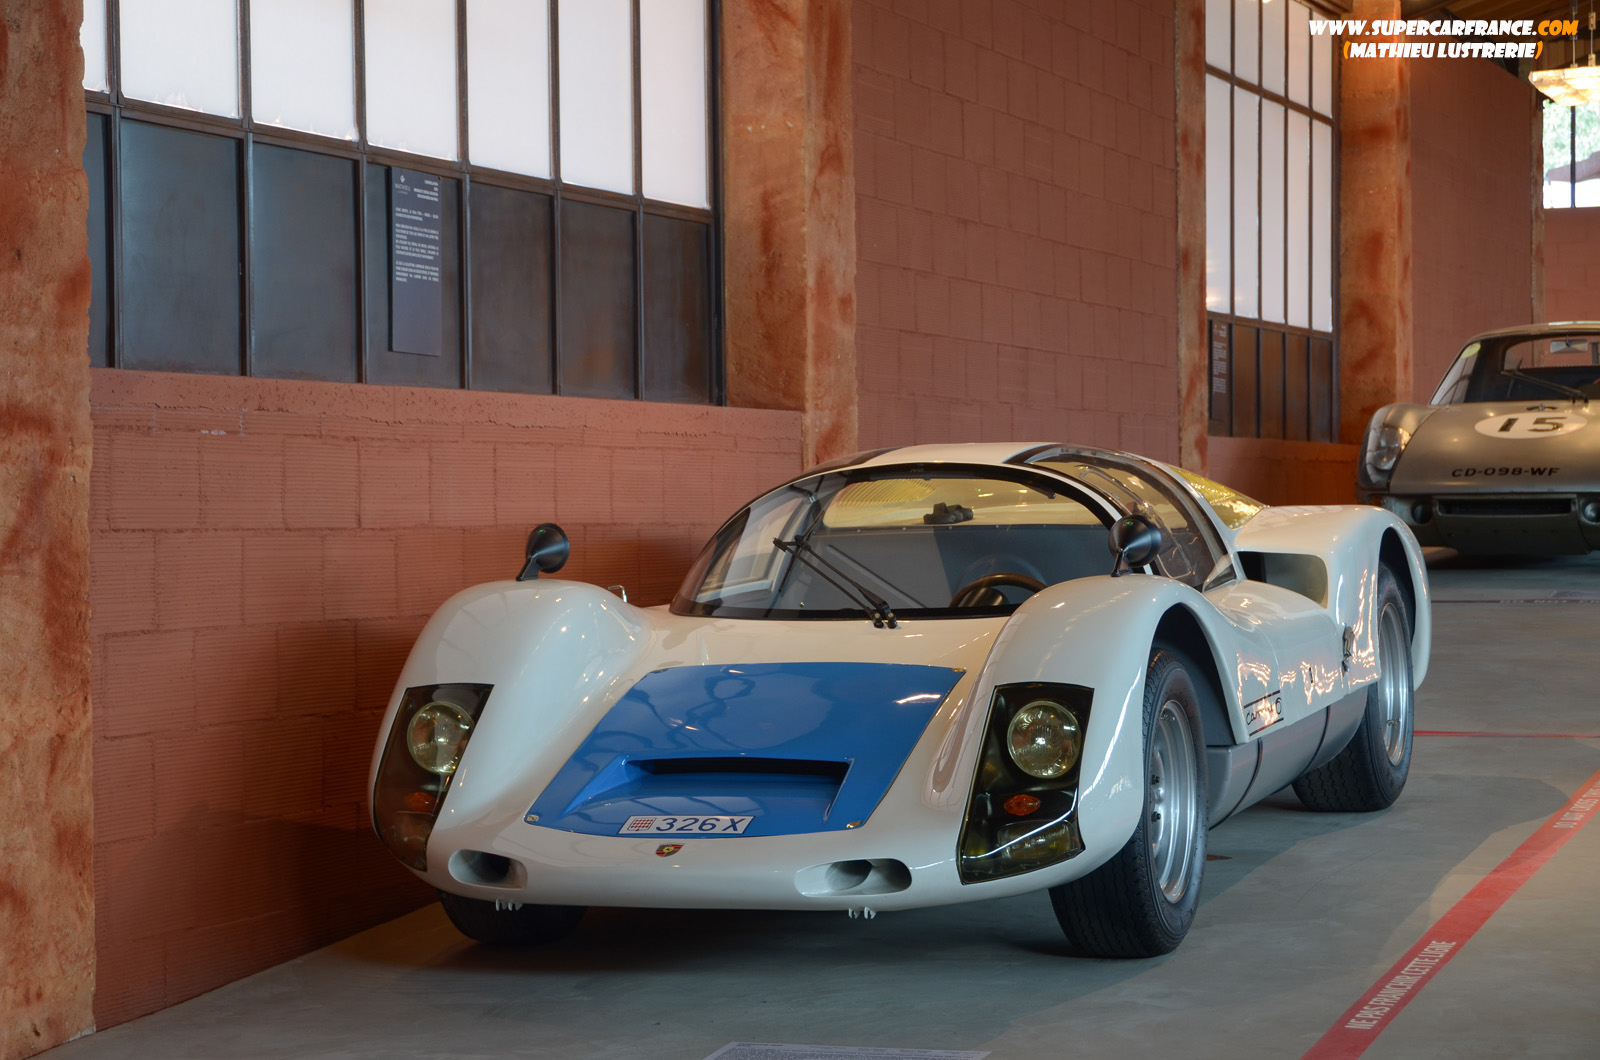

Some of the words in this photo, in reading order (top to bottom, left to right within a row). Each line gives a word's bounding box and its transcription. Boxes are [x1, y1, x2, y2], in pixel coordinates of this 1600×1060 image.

[1497, 416, 1568, 433] 15
[1451, 467, 1560, 478] CD-098-WF
[1418, 940, 1457, 958] LIGNE
[1400, 957, 1440, 975] CETTE
[1368, 975, 1422, 1007] FRANCHIR
[1355, 1005, 1391, 1019] PAS
[1344, 1018, 1379, 1030] NE
